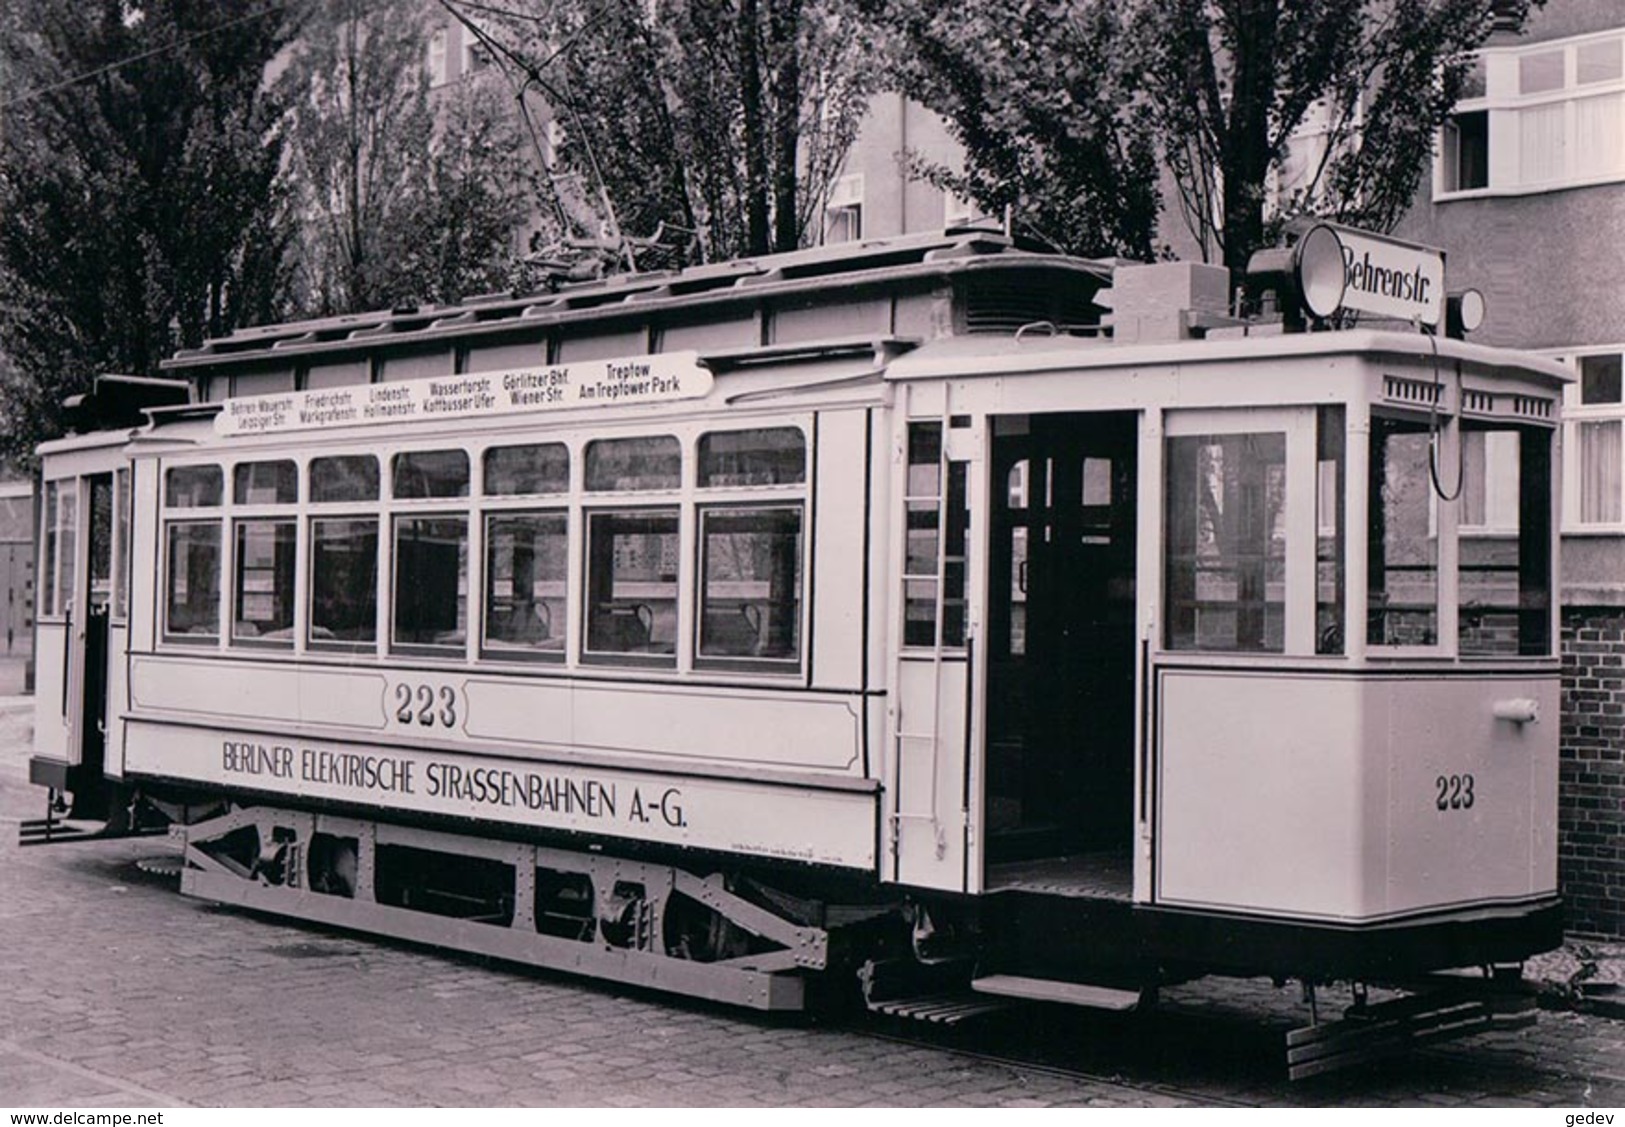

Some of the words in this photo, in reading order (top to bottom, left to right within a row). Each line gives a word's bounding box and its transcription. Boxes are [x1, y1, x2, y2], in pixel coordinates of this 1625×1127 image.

[1343, 245, 1431, 304] Behrenstr.
[503, 373, 549, 390] Görlitzer
[606, 362, 651, 381] Treptow
[510, 390, 545, 406] Wiener
[579, 384, 596, 399] Am
[596, 379, 651, 400] Treptower
[651, 375, 681, 393] Park
[474, 392, 496, 409] Ufer
[395, 683, 456, 728] 223
[222, 742, 294, 778] BERLINER
[301, 750, 415, 793] ELEKTRISCHE
[426, 763, 616, 817] STRASSENBAHNEN
[629, 787, 688, 828] A.-G.
[1436, 773, 1475, 811] 223
